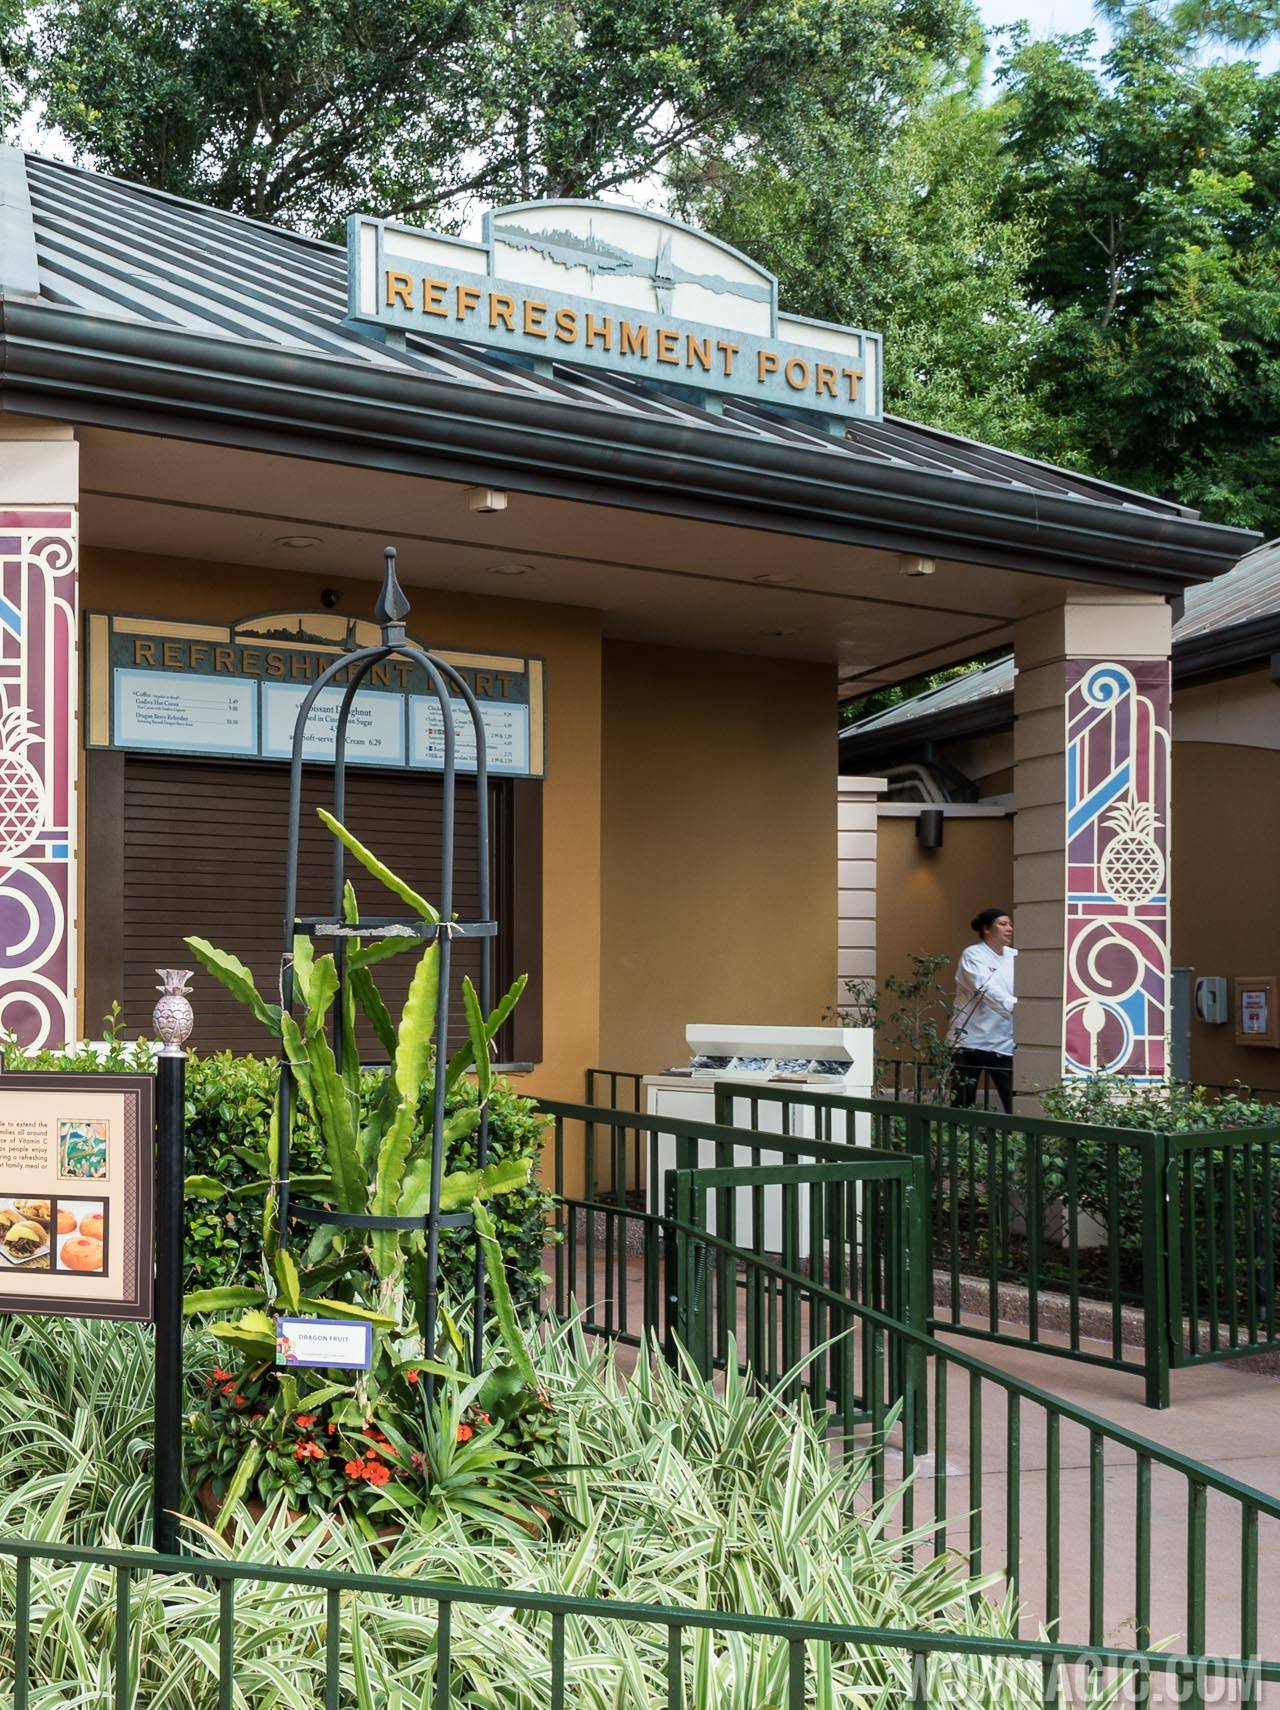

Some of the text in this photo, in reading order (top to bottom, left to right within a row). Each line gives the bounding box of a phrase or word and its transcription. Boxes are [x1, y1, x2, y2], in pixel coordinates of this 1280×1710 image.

[384, 269, 864, 401] REFRESHMENT PORT
[300, 704, 371, 717] oissant Dghnut
[356, 718, 373, 726] Sugar
